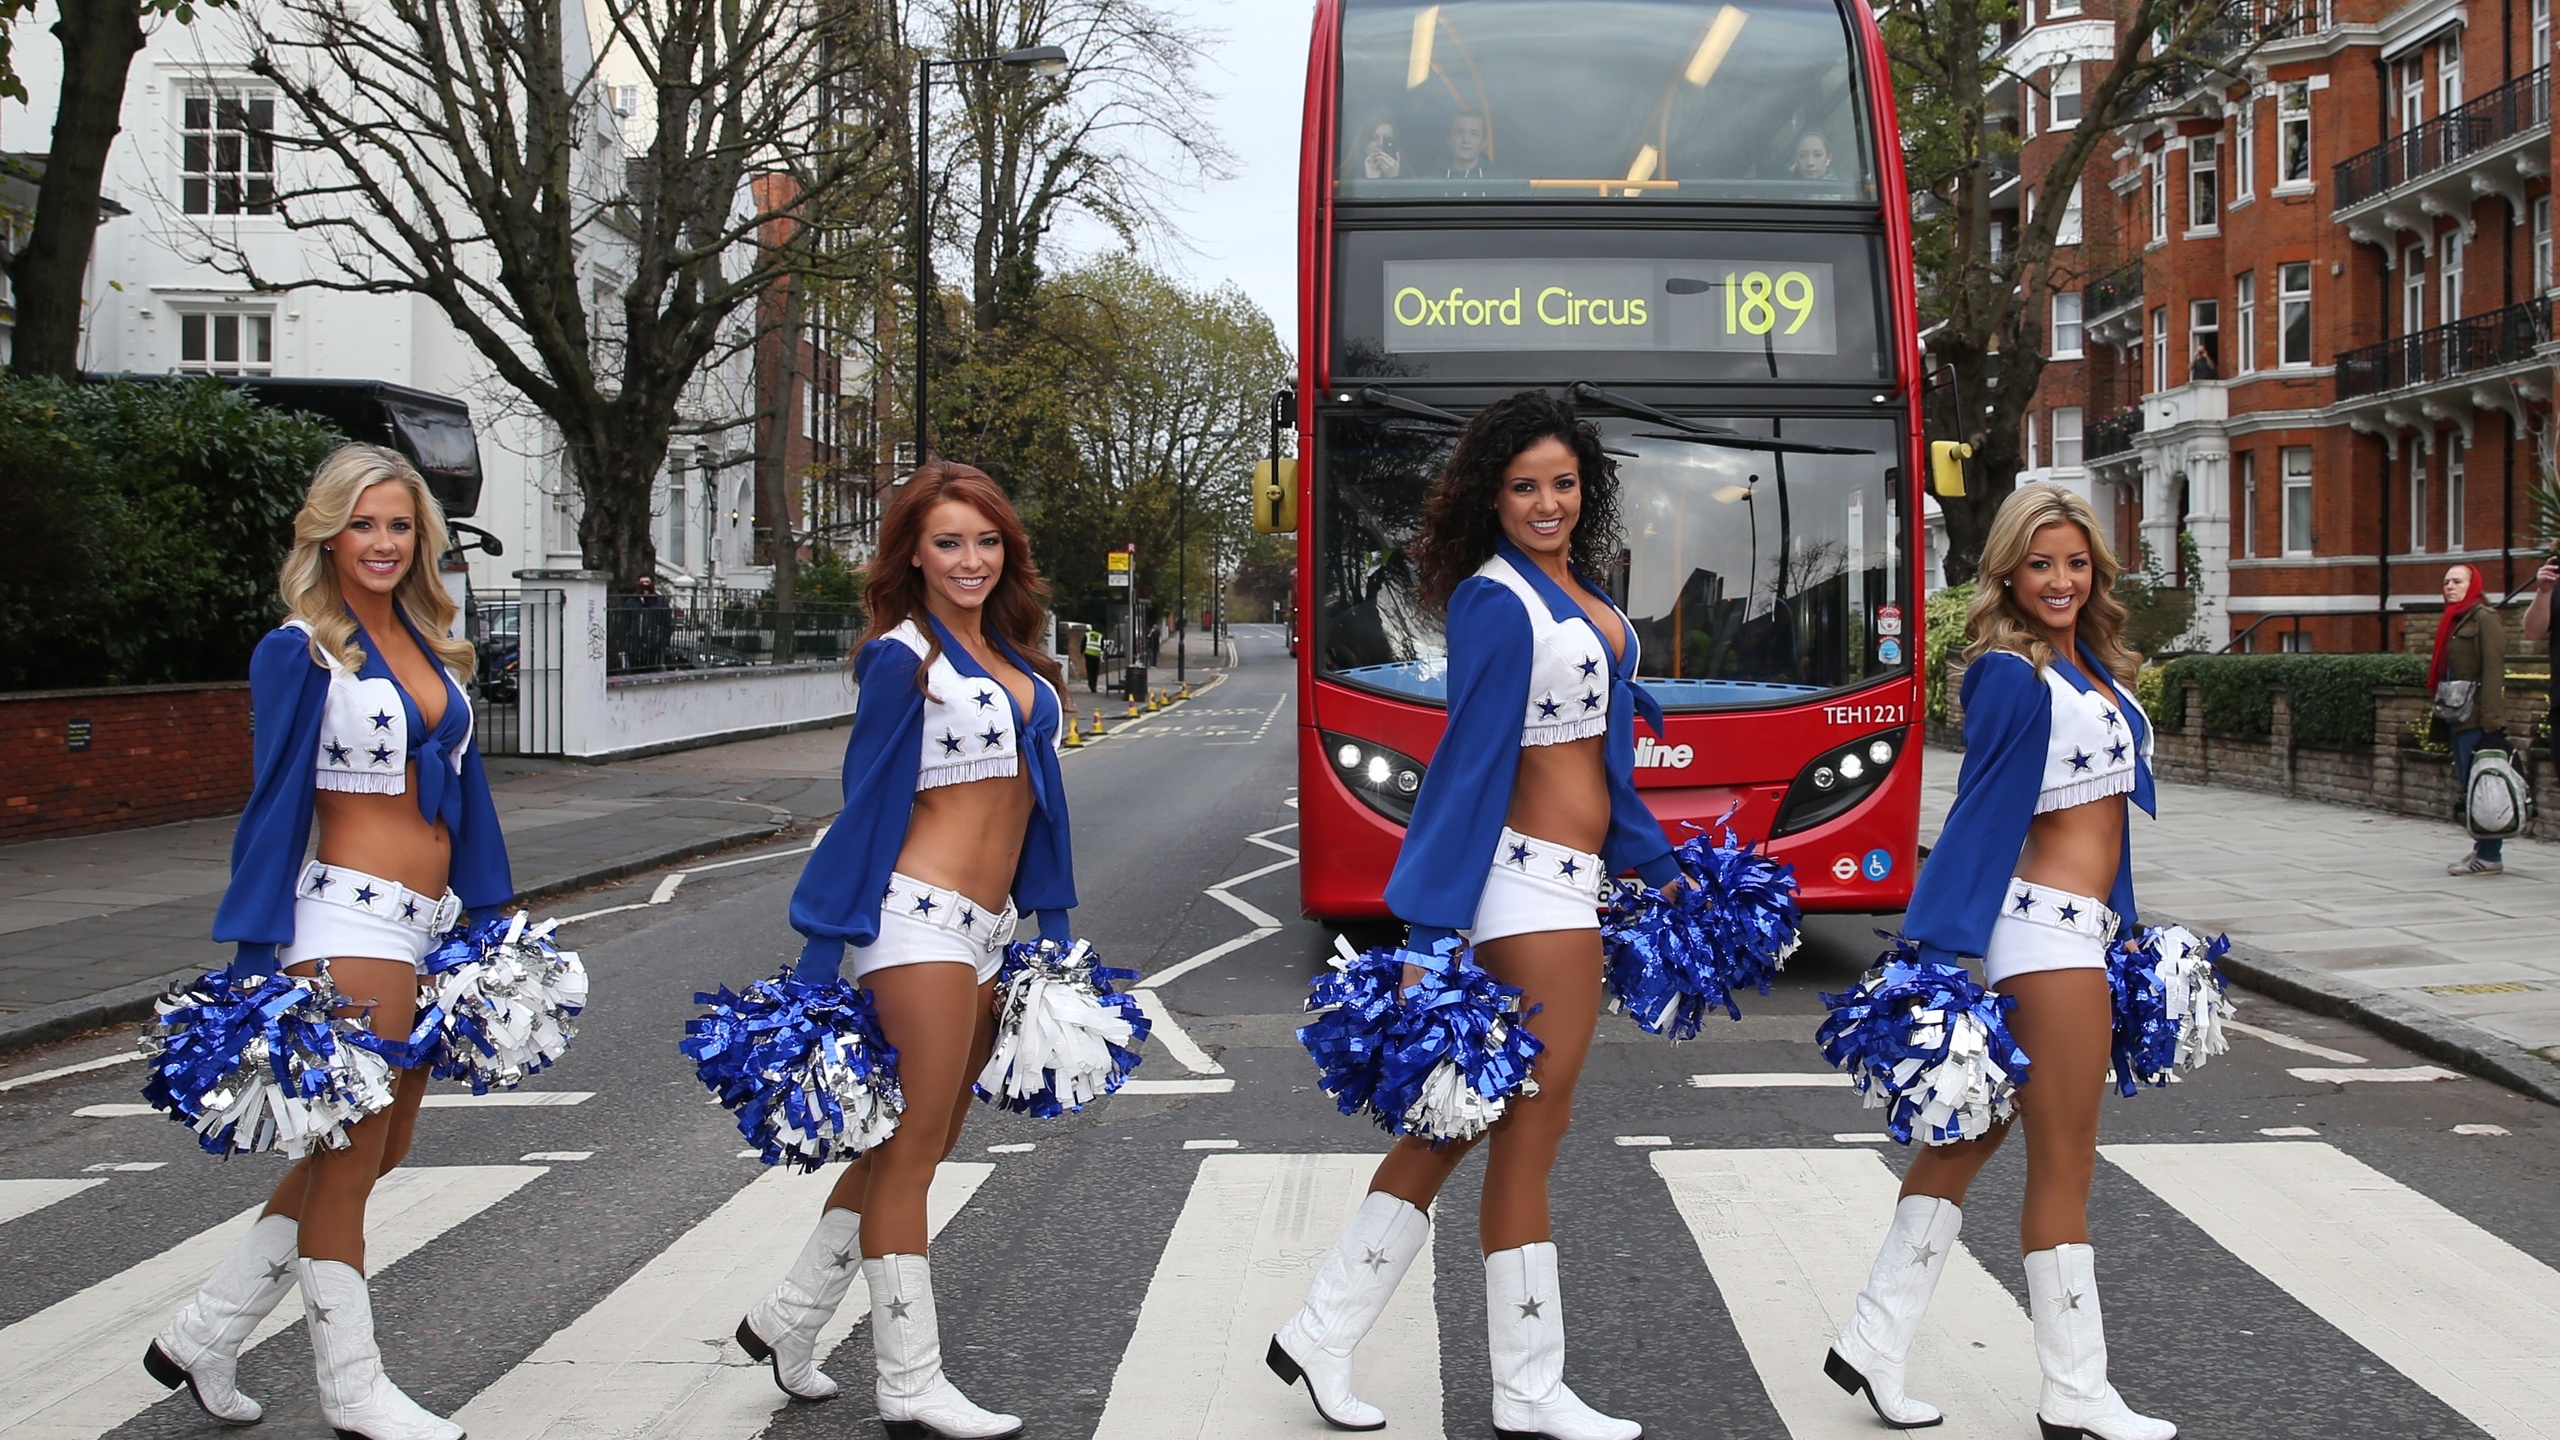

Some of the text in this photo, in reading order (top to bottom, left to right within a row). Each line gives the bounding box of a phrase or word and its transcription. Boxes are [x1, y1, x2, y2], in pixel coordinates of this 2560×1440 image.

[1394, 286, 1648, 326] Oxford Circus
[1725, 270, 1815, 335] 189
[1128, 543, 1135, 552] R
[1823, 704, 1904, 725] TEH1221
[1633, 736, 1695, 769] line
